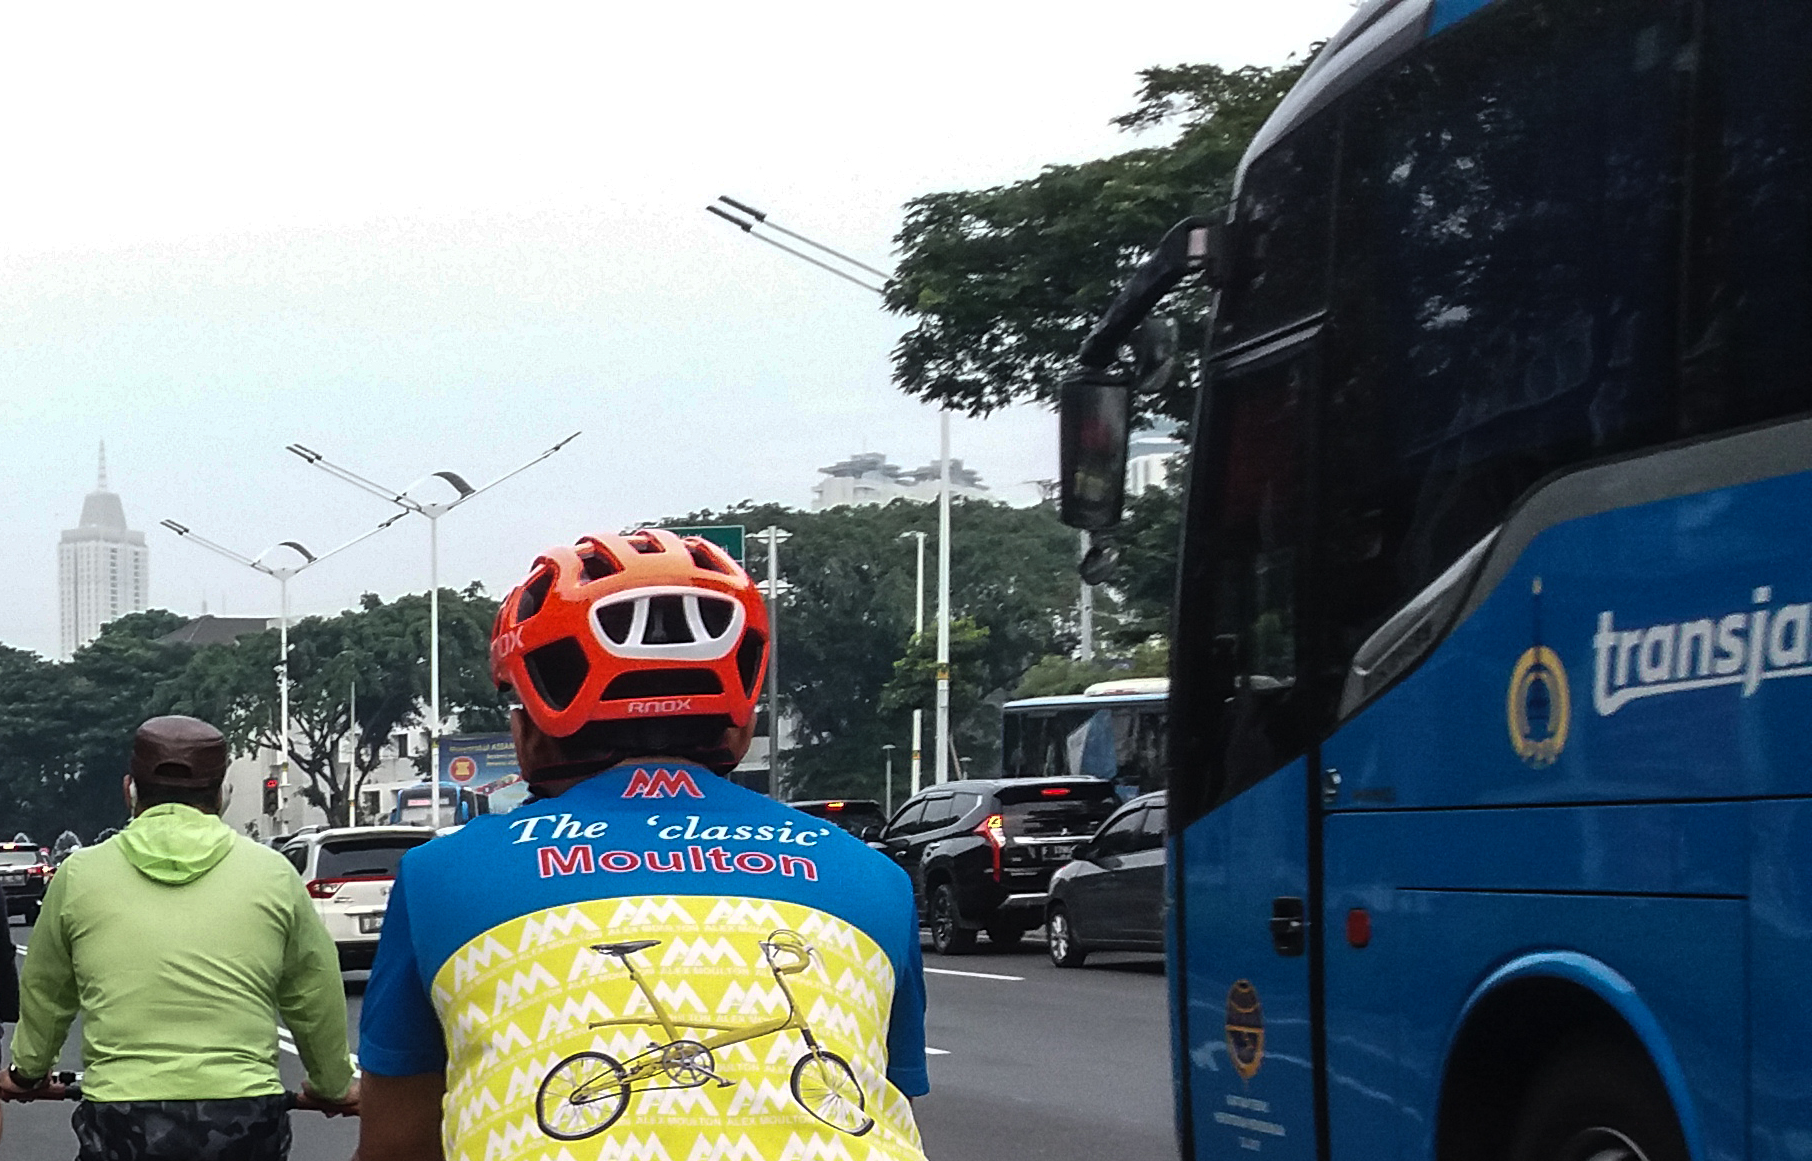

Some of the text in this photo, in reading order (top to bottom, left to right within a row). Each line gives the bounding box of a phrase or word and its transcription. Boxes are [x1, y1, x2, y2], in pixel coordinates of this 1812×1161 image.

[494, 625, 525, 657] OX
[509, 813, 609, 845] The
[536, 844, 819, 882] Moulton
